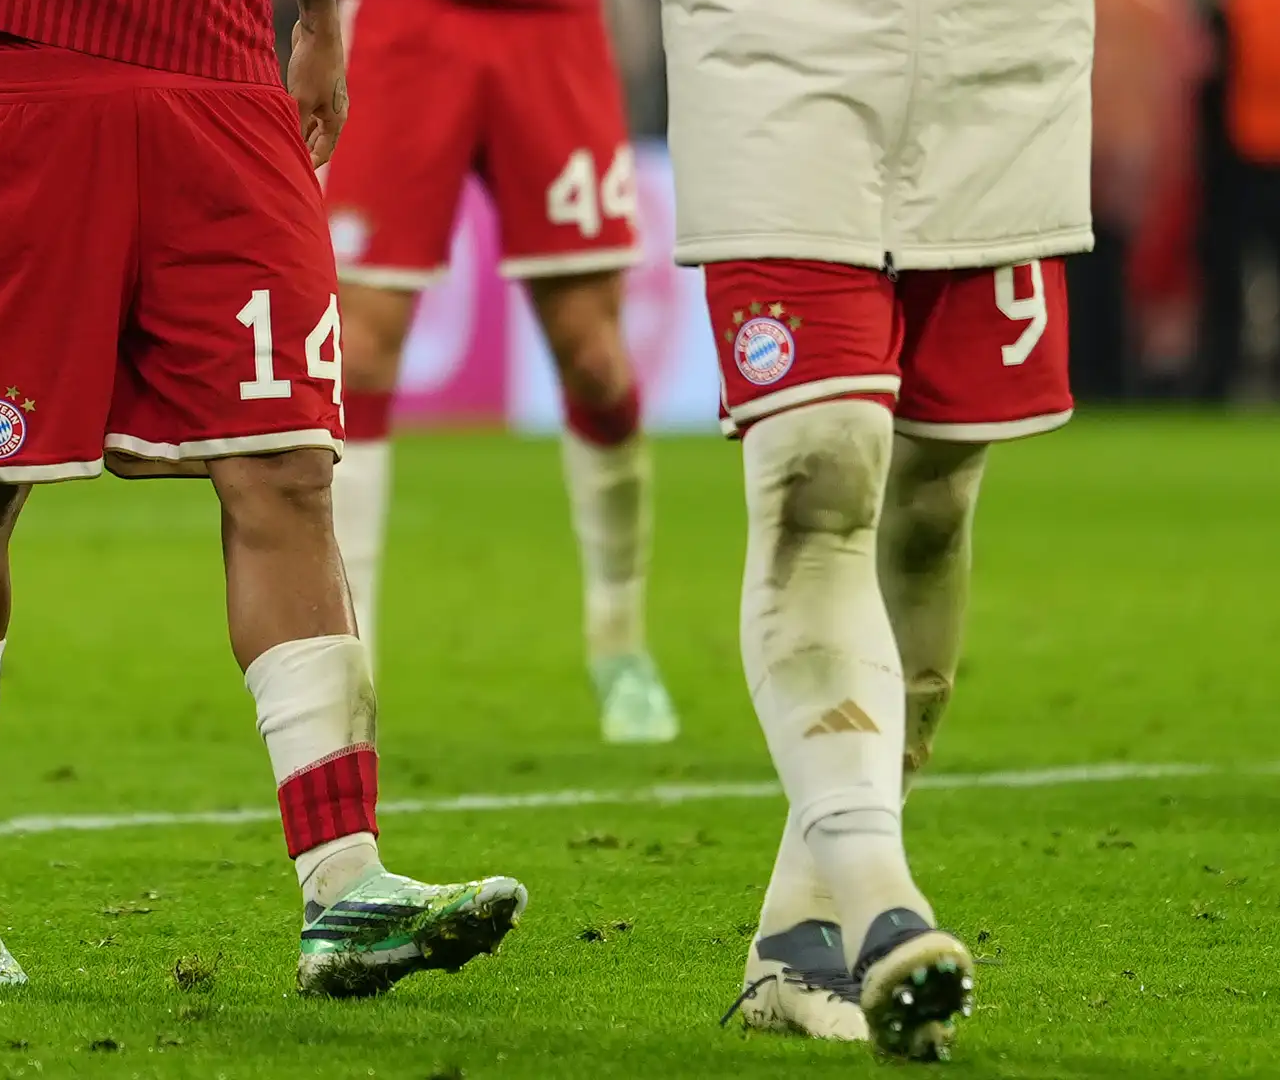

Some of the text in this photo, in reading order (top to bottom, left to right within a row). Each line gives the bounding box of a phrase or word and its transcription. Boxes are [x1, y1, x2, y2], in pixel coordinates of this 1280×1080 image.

[545, 144, 637, 238] 44
[235, 288, 342, 406] 14
[994, 258, 1047, 366] 9
